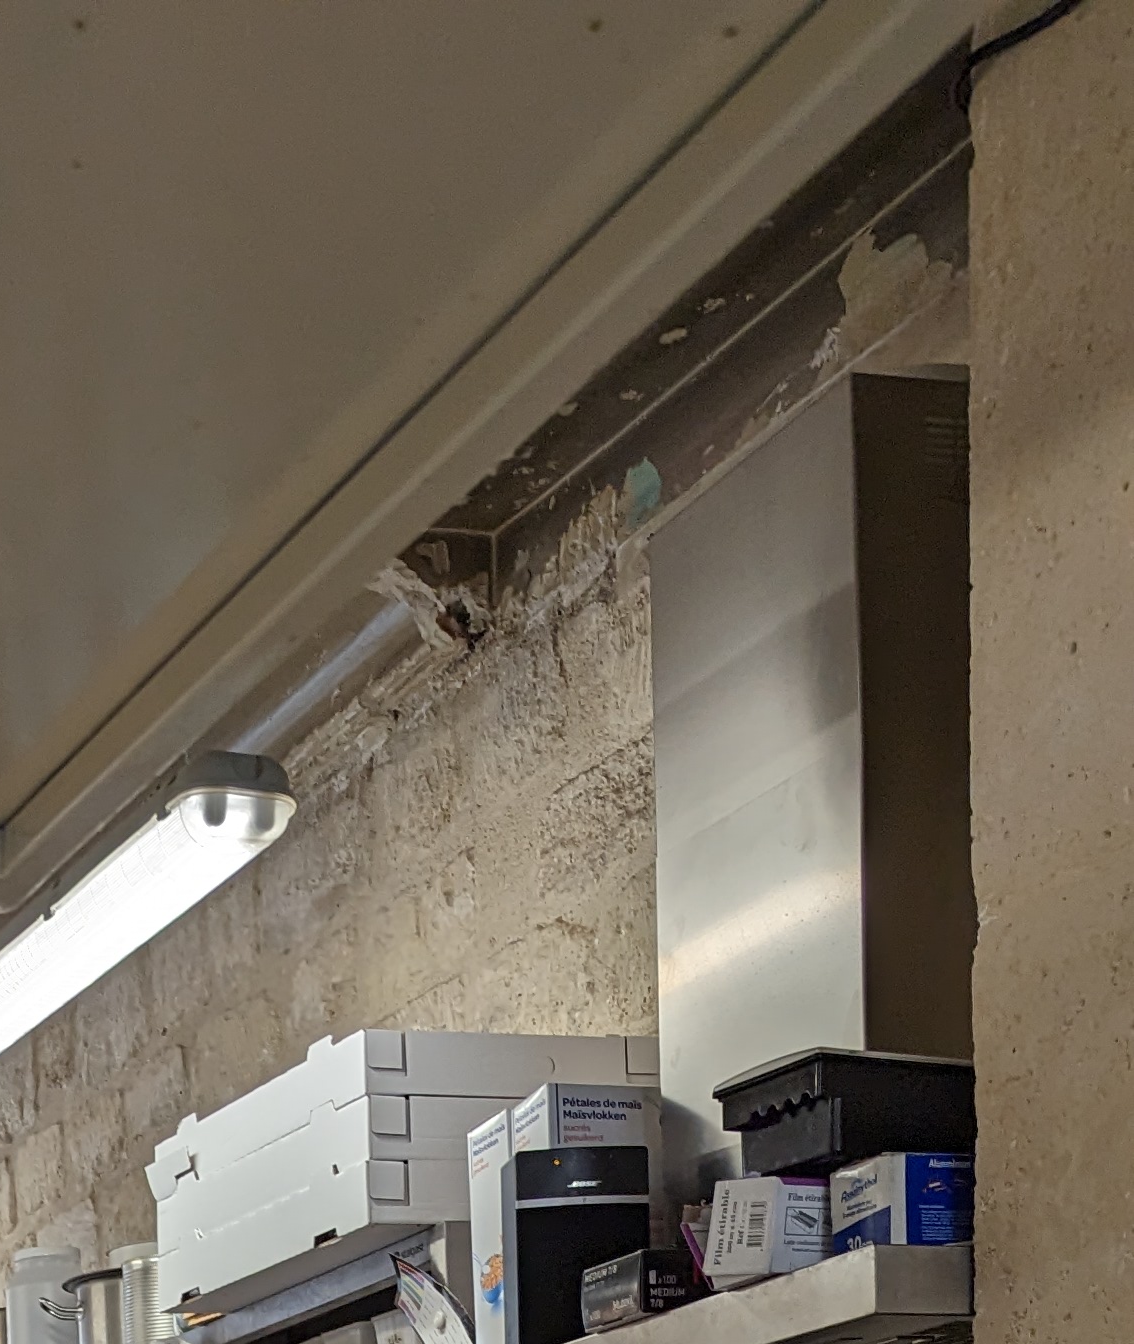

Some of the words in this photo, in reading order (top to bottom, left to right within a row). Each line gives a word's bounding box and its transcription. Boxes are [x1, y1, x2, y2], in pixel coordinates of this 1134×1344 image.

[562, 1097, 601, 1108] Pétales
[603, 1098, 616, 1109] de
[617, 1099, 642, 1110] maïs
[563, 1110, 626, 1121] Maïsvlokken
[788, 1192, 804, 1202] Film
[718, 1189, 730, 1236] étirable
[713, 1238, 725, 1266] Film
[650, 1287, 685, 1297] MEDIUM
[650, 1298, 664, 1309] 7/8
